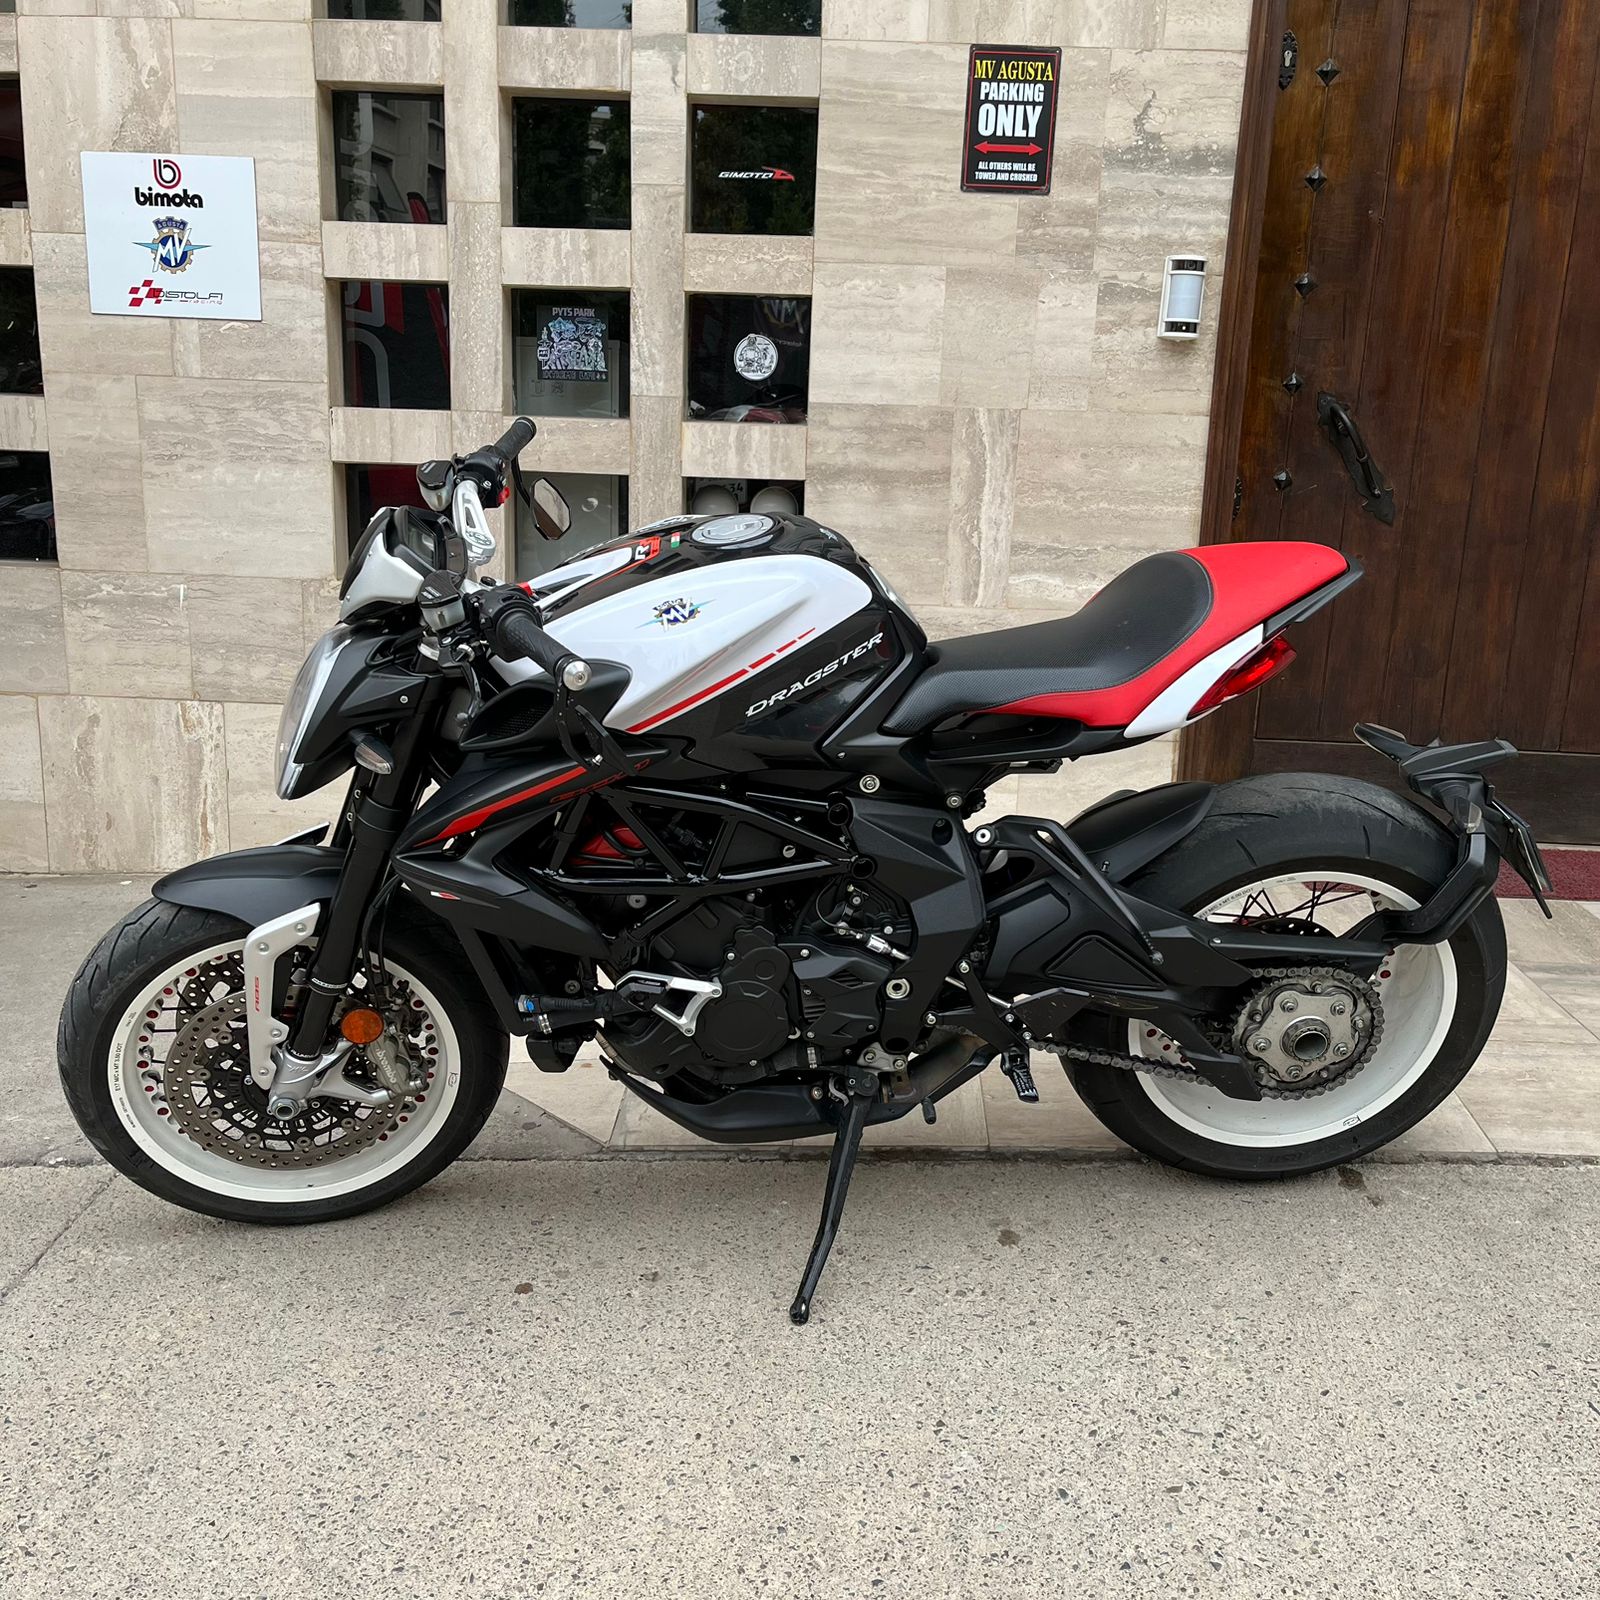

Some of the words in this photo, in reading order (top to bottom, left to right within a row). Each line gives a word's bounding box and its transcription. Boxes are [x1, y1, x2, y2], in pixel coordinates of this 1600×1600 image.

[974, 60, 996, 79] MV
[997, 61, 1054, 81] AGUSTA
[980, 82, 1045, 102] PARKING
[977, 103, 1043, 138] ONLY
[718, 171, 774, 179] GIMOTO
[975, 171, 996, 180] TOWED
[997, 172, 1010, 181] AND
[1010, 172, 1038, 182] CRUSHED
[978, 161, 989, 170] ALL
[989, 161, 1012, 171] OTHERS
[1012, 162, 1027, 171] WILL
[1027, 163, 1036, 172] BE
[134, 186, 204, 209] bimota
[152, 228, 192, 273] MV
[573, 308, 595, 317] PARK
[745, 632, 884, 718] DRAGSTER
[375, 1050, 397, 1084] brembo
